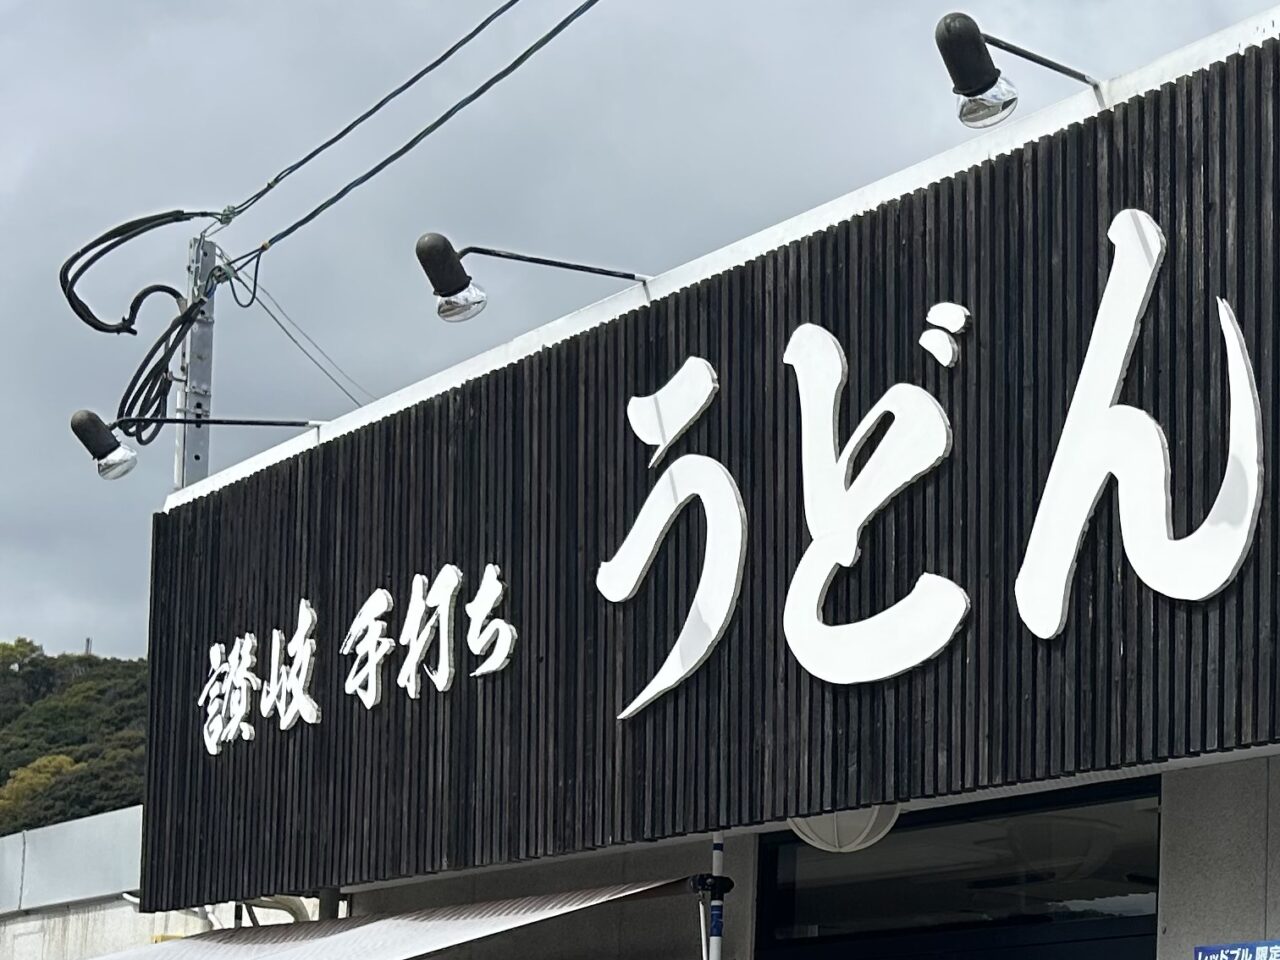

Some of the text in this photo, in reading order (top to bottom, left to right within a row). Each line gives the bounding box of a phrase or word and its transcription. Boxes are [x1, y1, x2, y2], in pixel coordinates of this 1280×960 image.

[340, 562, 518, 710] 手打ち
[596, 208, 1265, 721] うどん
